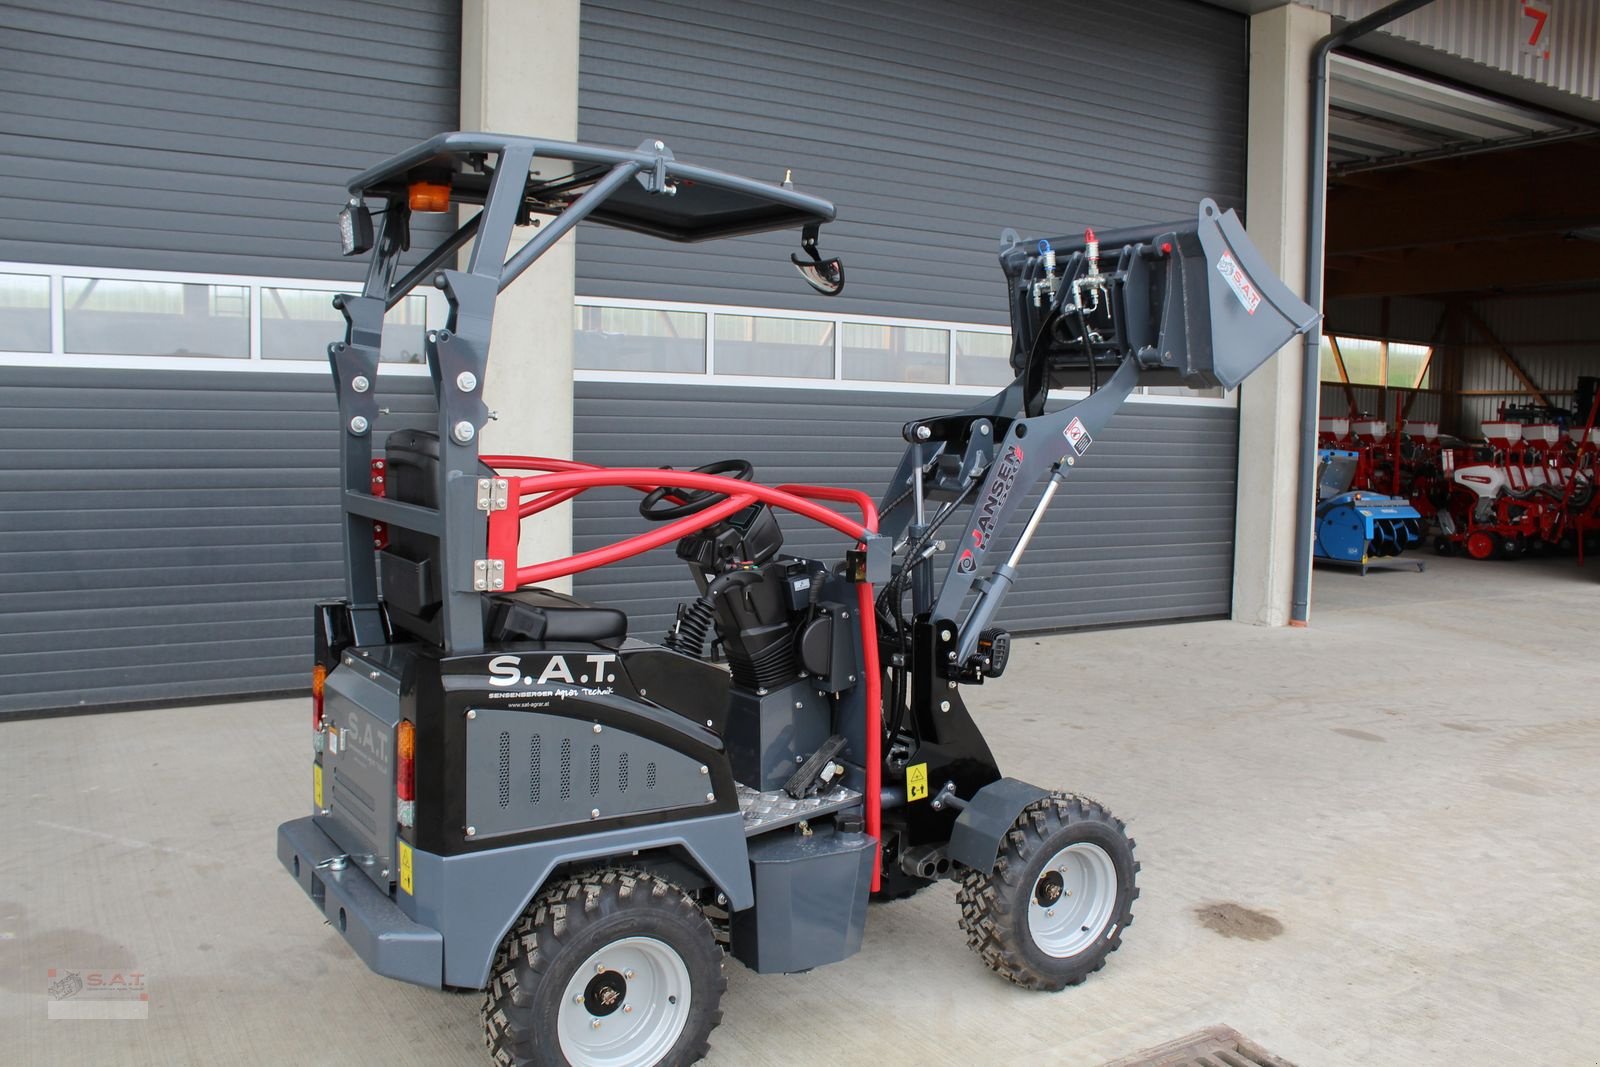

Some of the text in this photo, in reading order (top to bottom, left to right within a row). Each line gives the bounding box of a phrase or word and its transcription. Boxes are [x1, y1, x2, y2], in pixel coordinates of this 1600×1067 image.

[1524, 6, 1548, 46] 7
[972, 446, 1016, 548] JANSEN
[488, 653, 616, 686] S.A.T.
[488, 690, 553, 699] SENSENBERGER
